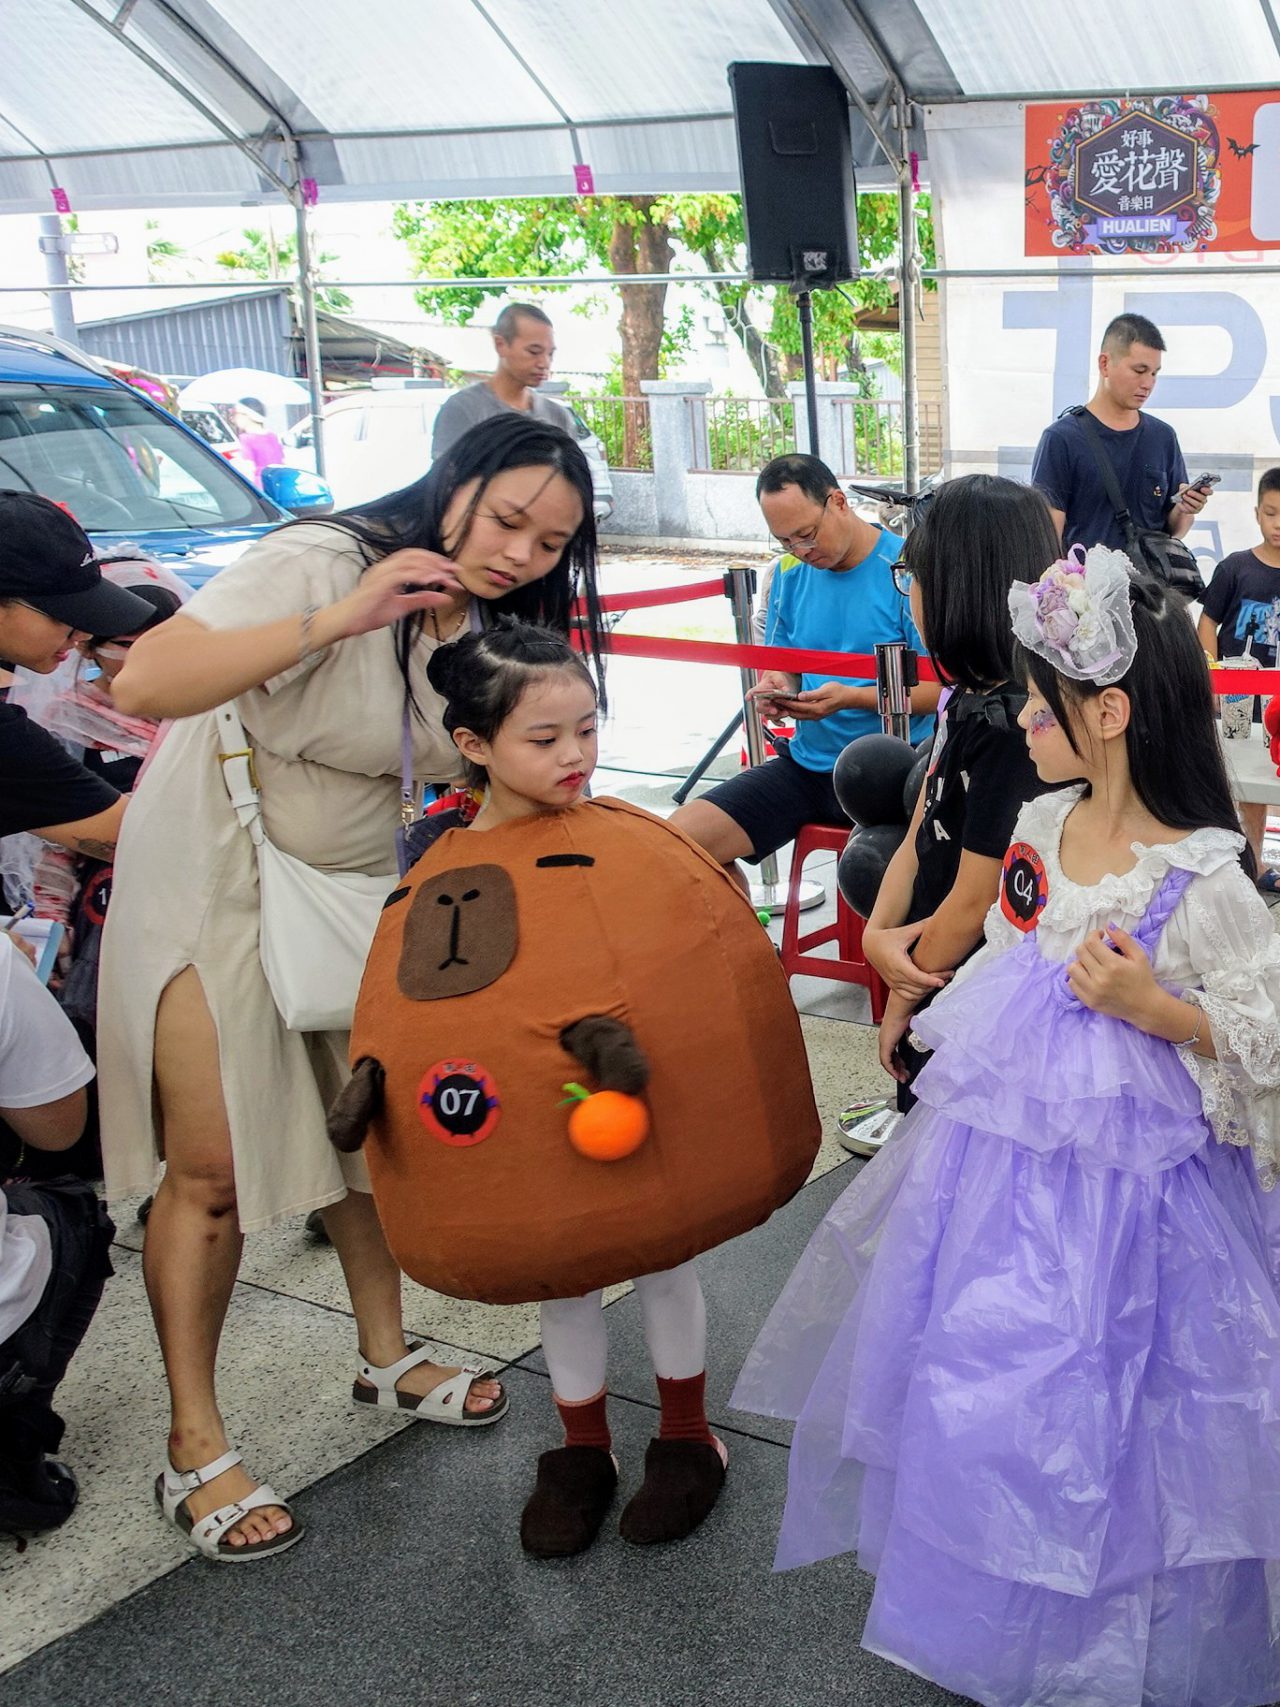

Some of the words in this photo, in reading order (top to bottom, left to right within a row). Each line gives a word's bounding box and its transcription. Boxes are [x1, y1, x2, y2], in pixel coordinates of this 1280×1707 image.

[1121, 128, 1154, 148] 好事
[1089, 146, 1188, 196] 愛花聲
[1118, 195, 1154, 212] 音樂日
[1102, 218, 1172, 234] HUALIEN
[1014, 869, 1034, 906] 04
[440, 1087, 481, 1116] 07
